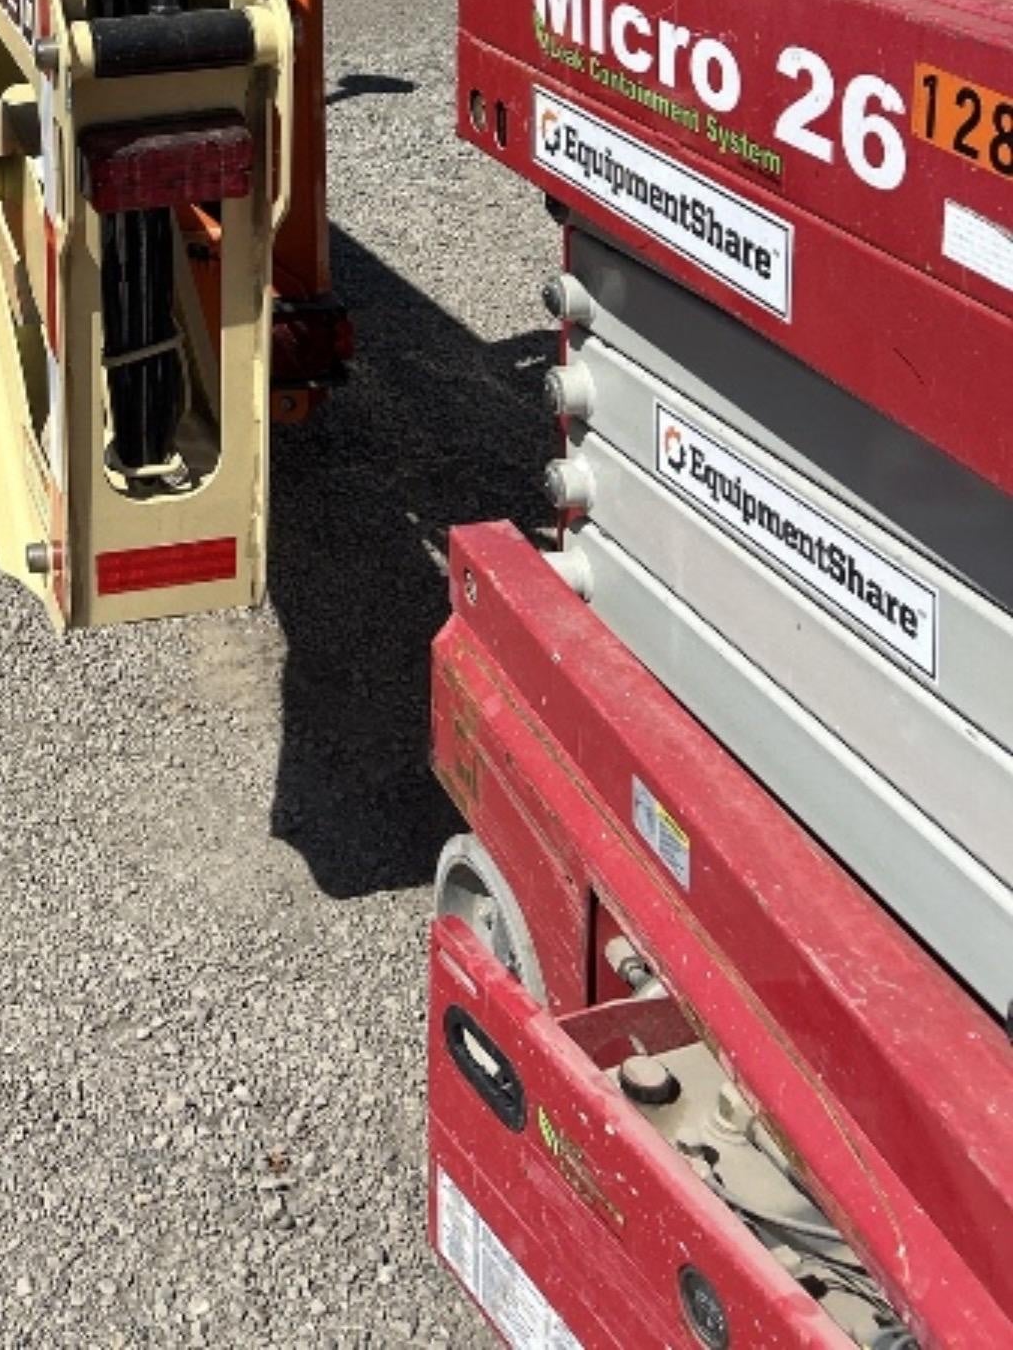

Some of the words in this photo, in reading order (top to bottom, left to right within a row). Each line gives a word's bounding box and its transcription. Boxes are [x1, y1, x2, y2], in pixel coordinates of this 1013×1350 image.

[590, 56, 700, 134] Containment
[706, 114, 782, 175] System
[774, 45, 907, 190] 26
[922, 73, 1013, 177] 128
[564, 125, 772, 280] EquipmentShare
[689, 443, 919, 640] EquipmentShare
